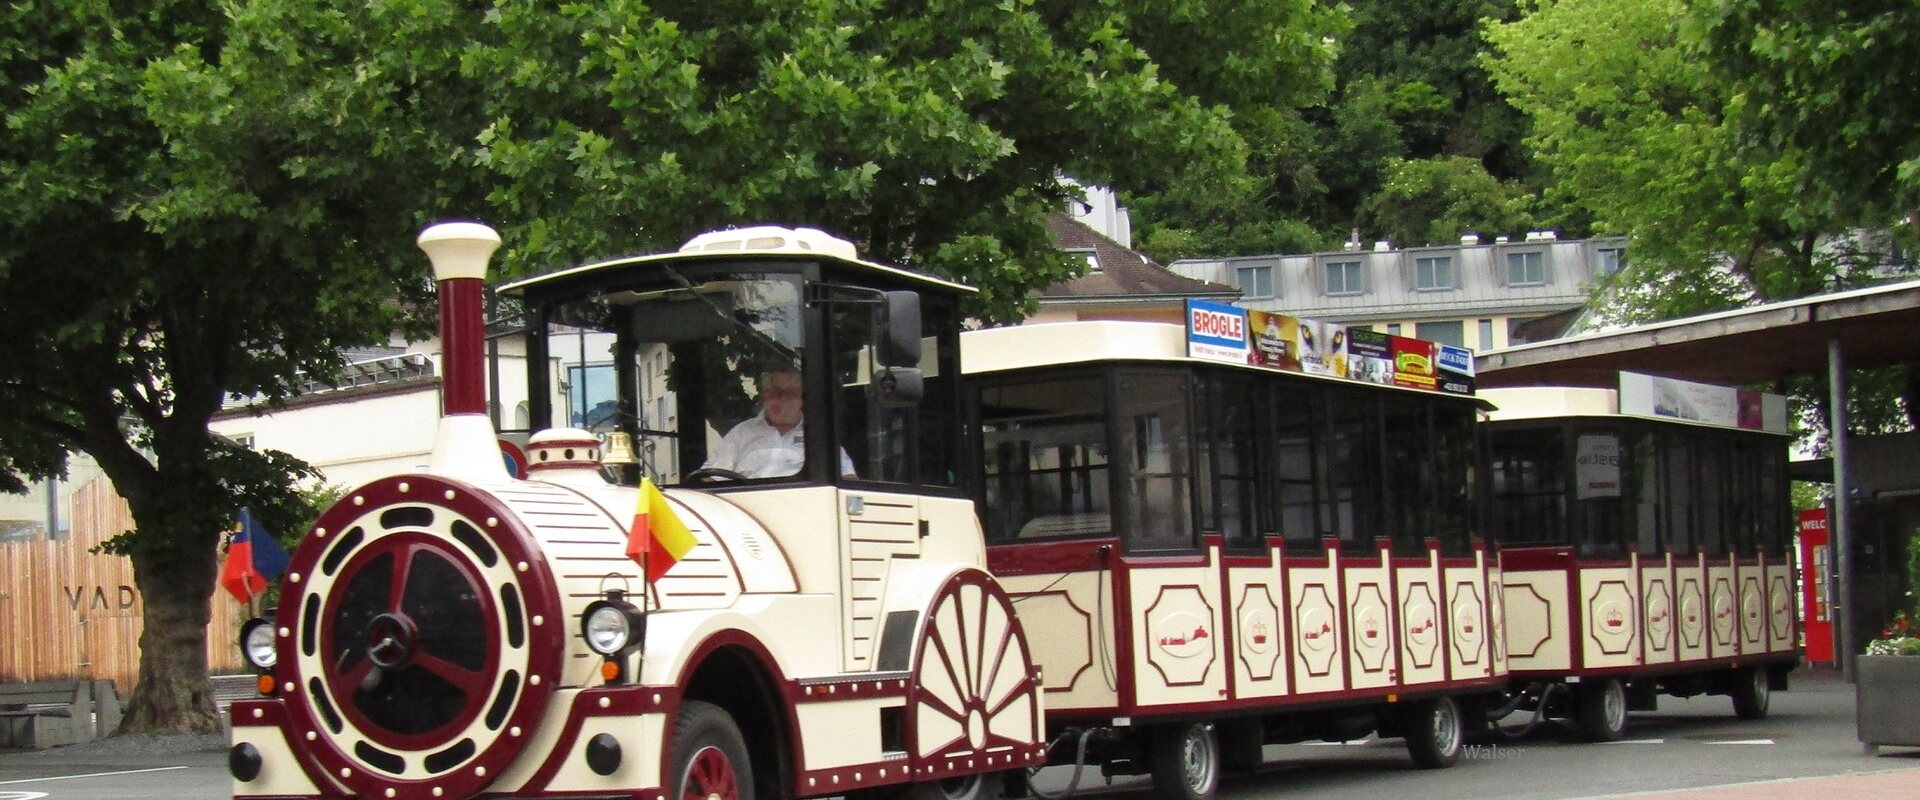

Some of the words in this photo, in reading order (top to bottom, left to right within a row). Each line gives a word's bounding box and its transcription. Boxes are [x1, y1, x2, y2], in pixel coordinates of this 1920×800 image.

[1193, 311, 1242, 338] BROGLE
[1802, 519, 1826, 530] WELC
[64, 585, 135, 610] VAD
